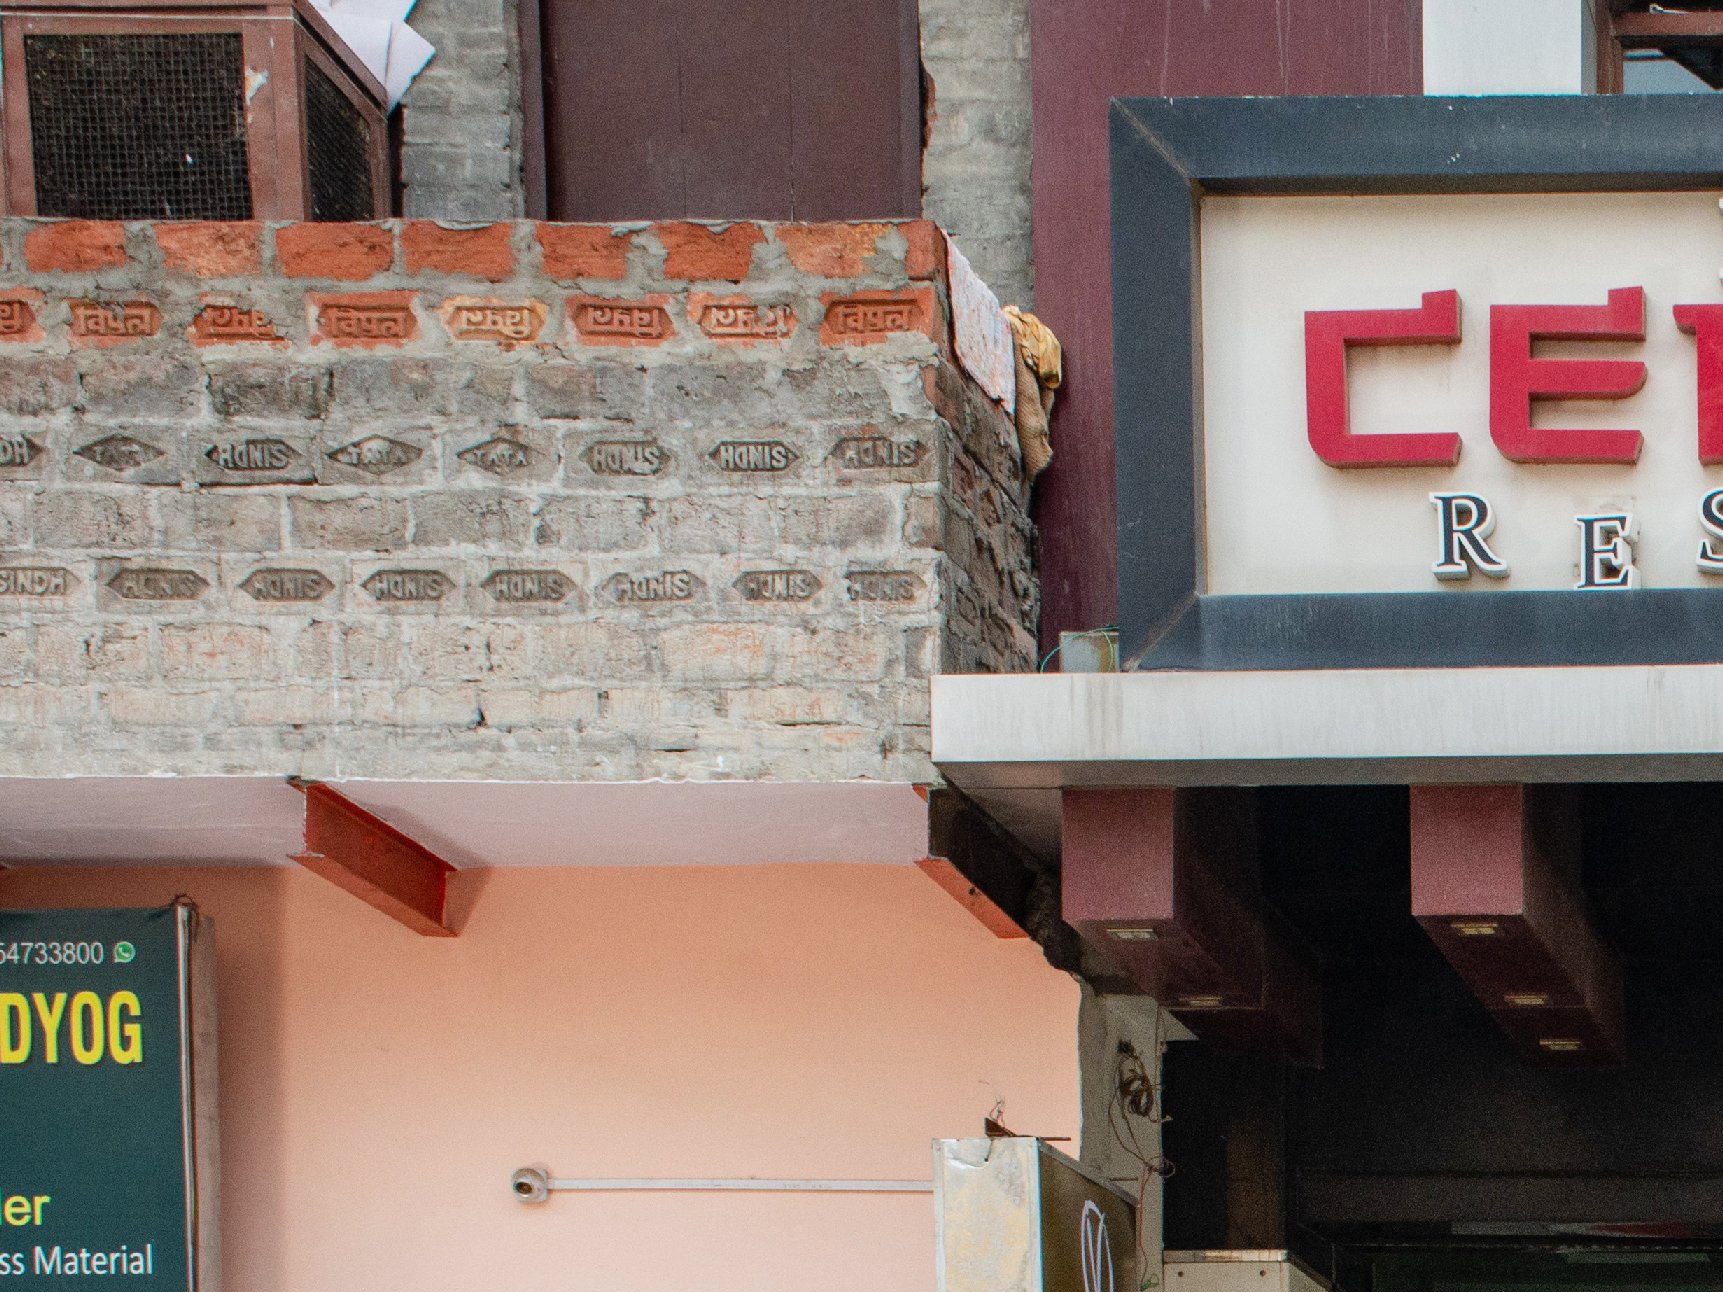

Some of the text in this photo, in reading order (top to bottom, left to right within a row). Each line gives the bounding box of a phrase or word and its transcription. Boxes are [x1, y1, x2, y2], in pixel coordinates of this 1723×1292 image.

[0, 990, 144, 1066] DYOG
[0, 1190, 51, 1227] er
[34, 1243, 154, 1276] Material
